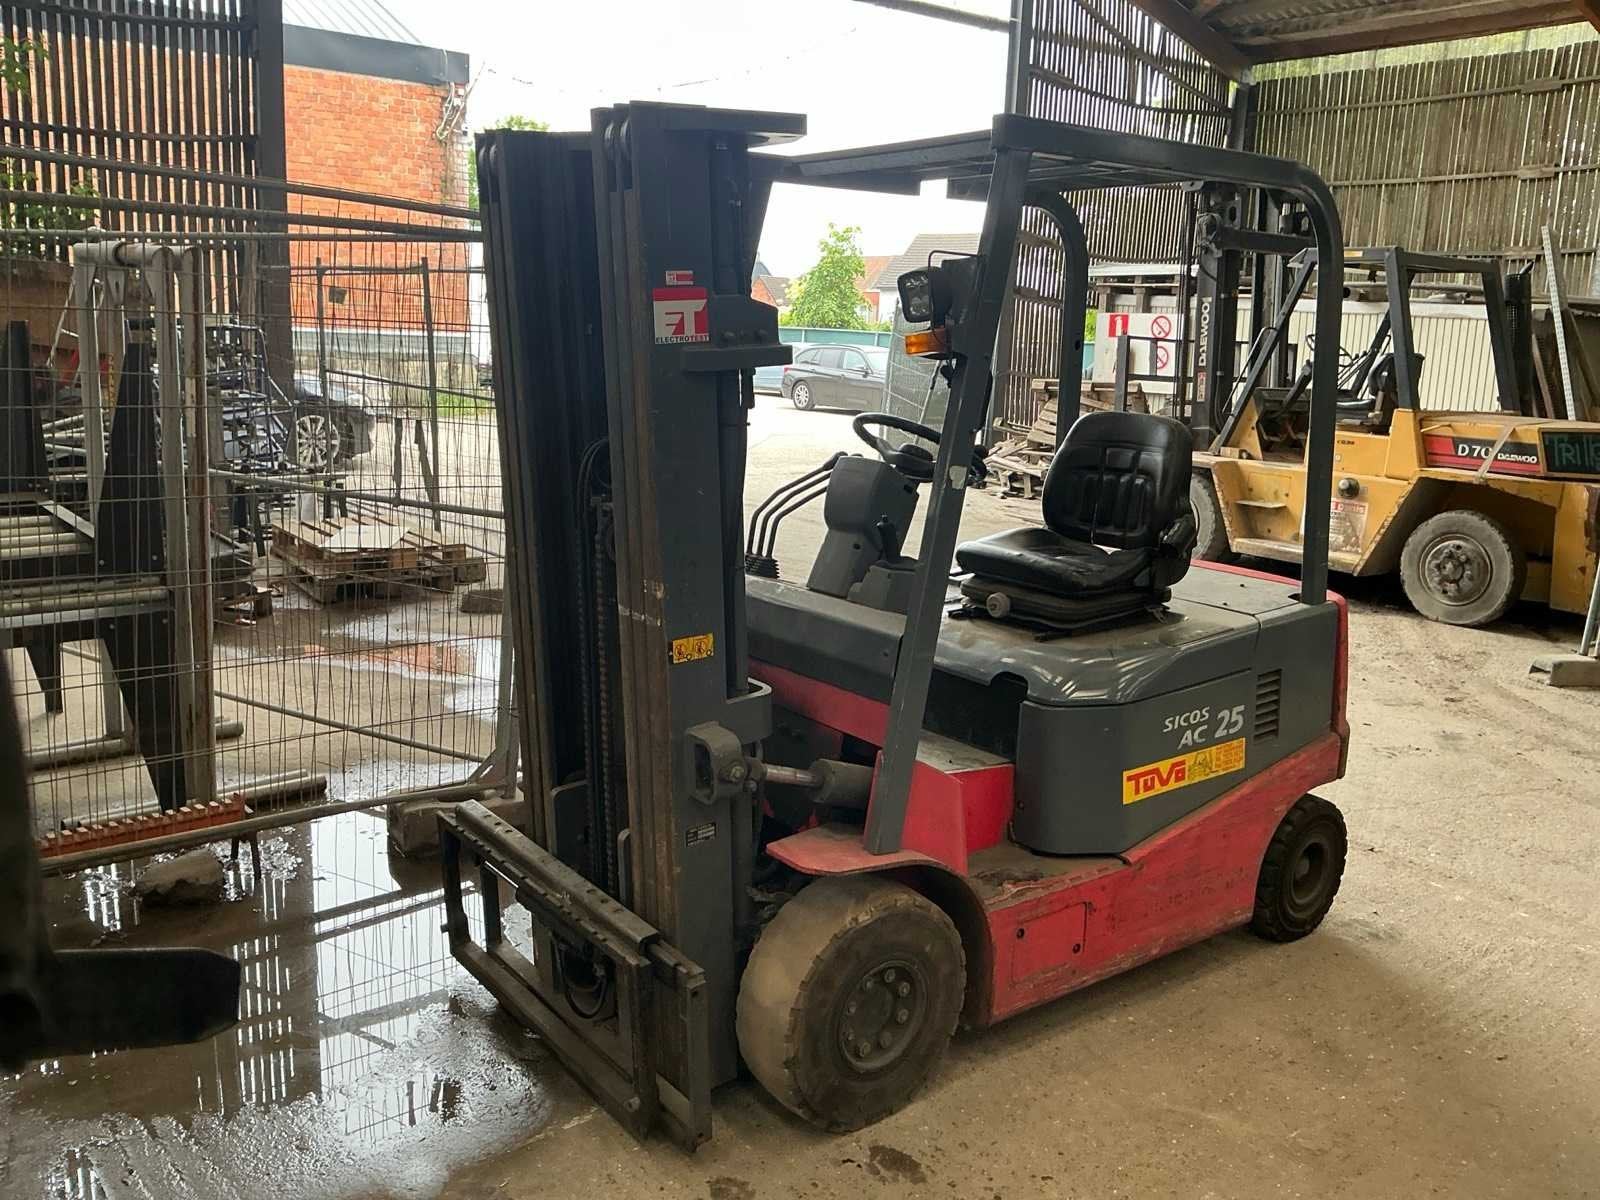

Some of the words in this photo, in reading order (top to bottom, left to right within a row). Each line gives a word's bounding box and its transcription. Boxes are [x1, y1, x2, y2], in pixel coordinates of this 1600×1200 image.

[656, 335, 711, 343] ELECTROTEST
[1198, 302, 1210, 366] DAEWOO
[1458, 444, 1469, 457] D
[1497, 452, 1538, 464] DAEWOO
[1163, 706, 1210, 732] SICOS
[1177, 725, 1208, 750] AC
[1214, 705, 1245, 738] 25
